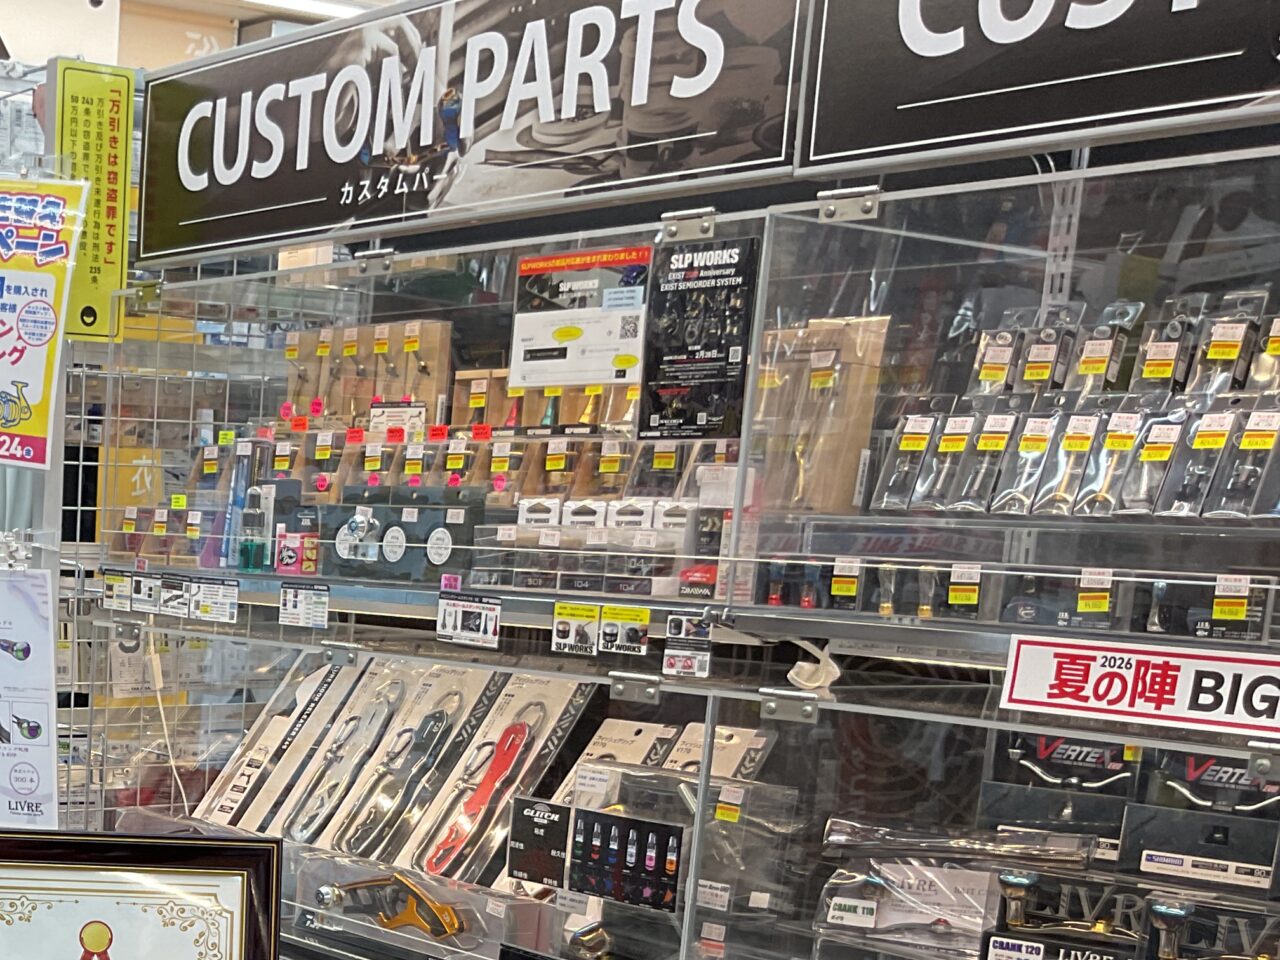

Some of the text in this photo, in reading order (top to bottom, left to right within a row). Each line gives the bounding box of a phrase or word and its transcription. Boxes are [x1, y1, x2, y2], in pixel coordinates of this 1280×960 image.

[176, 46, 438, 194] CUSTOM
[459, 0, 726, 142] PARTS
[670, 248, 740, 270] SLP WORKS
[668, 267, 736, 281] EXIST Anniversary
[660, 276, 742, 292] EXIST SEMIORDER SYSTEM
[555, 642, 594, 655] SLP WORKS
[601, 642, 641, 654] SLP WORKS
[1099, 654, 1134, 671] 2026
[1047, 651, 1181, 711] 夏の陣
[314, 680, 330, 704] HOOK
[1187, 669, 1280, 719] BIG
[291, 701, 318, 738] RELEASER
[1036, 735, 1118, 768] VERTEX
[8, 800, 43, 813] LIVRE
[523, 808, 560, 822] GLITCH
[992, 939, 1041, 956] CRANK 120
